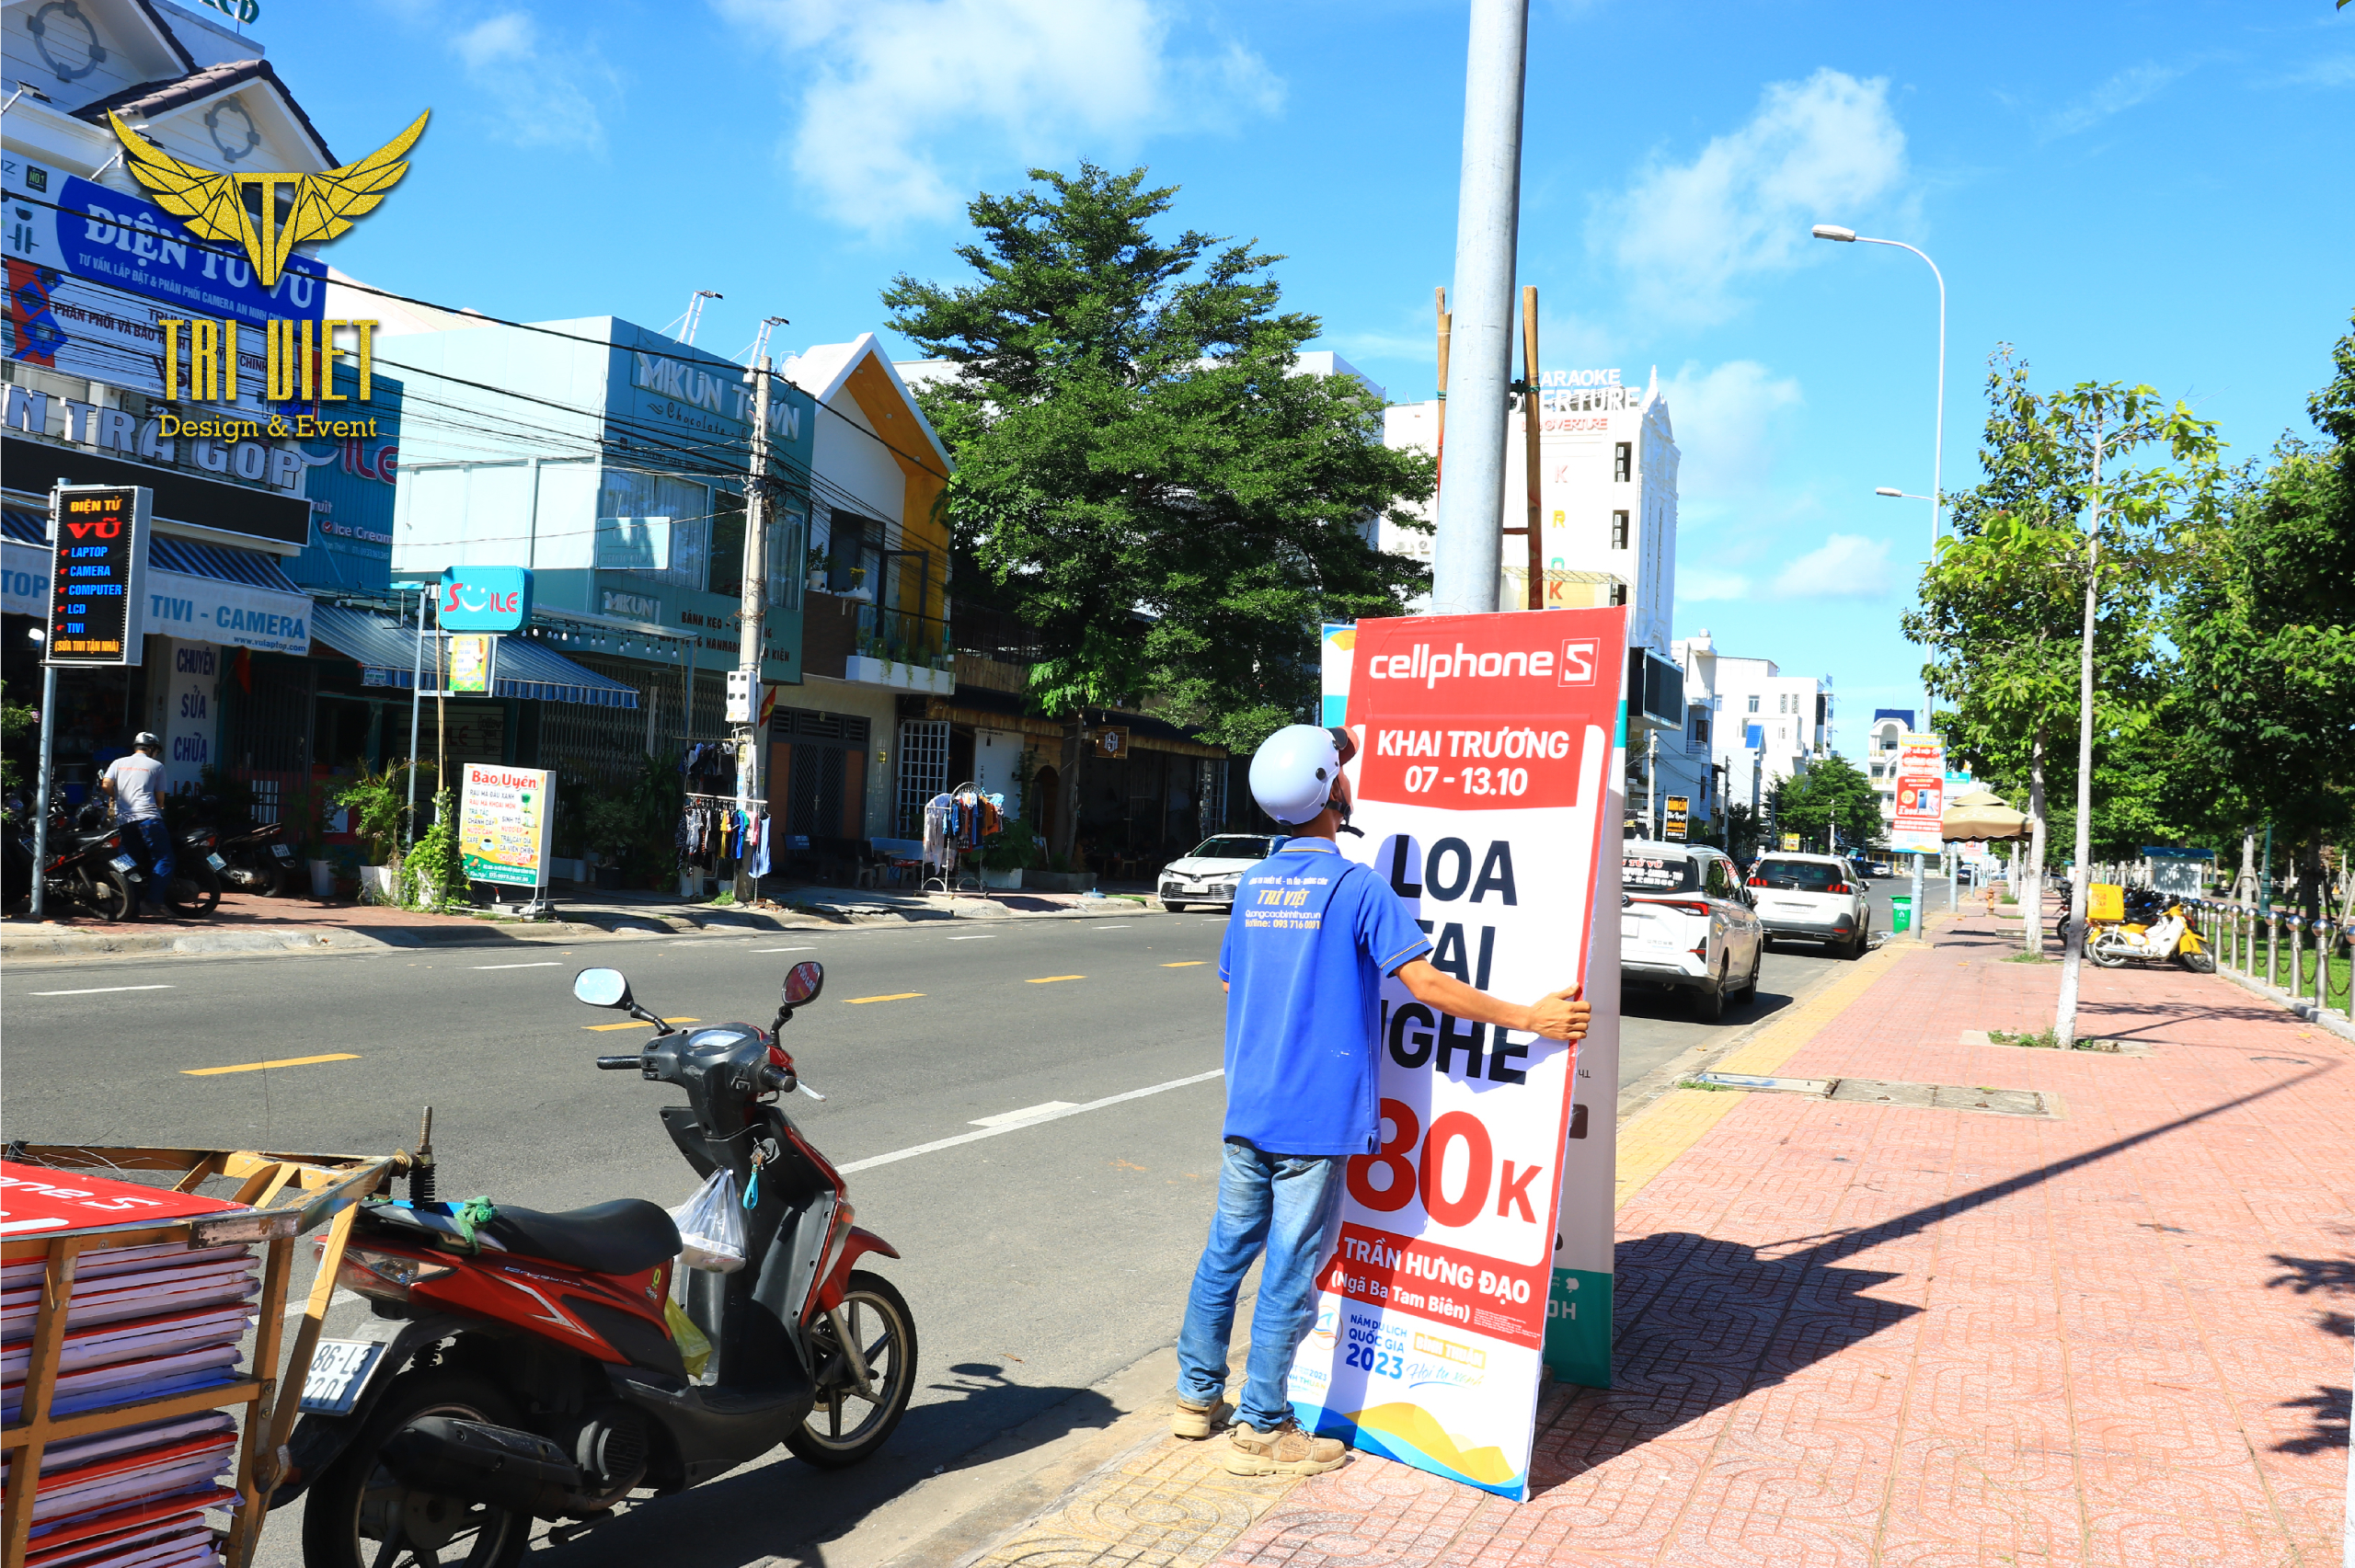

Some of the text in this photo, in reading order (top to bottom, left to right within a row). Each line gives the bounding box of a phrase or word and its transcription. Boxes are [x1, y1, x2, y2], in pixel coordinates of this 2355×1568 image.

[84, 203, 190, 269] ĐIỆN
[150, 276, 157, 287] &
[158, 278, 181, 295] PHÂN
[202, 293, 235, 313] CAMERA
[236, 302, 247, 315] AN
[249, 304, 267, 322] NINH
[1510, 387, 1640, 414] OERTURE
[668, 402, 725, 435] Chocolate
[71, 496, 122, 514] ĐIỆN TỬ
[67, 517, 122, 538] VŨ
[333, 522, 351, 537] Ice
[71, 546, 108, 557] LAPTOP
[70, 566, 110, 577] CAMERA
[68, 584, 121, 595] COMPUTER
[67, 604, 86, 614] LCD
[150, 594, 193, 622] TIVI
[216, 606, 305, 639] CAMERA
[681, 610, 704, 626] BÁNH
[707, 615, 722, 631] KẸO
[66, 623, 85, 634] TIVI
[54, 636, 119, 654] (SỬA TIVI TẬN NHÀ)
[234, 635, 306, 652] www.vulaptop.com
[177, 647, 215, 676] CHUYÊN
[181, 684, 206, 718] SỬA
[174, 732, 207, 762] CHỮA
[1376, 726, 1569, 759] KHAI TRƯƠNG
[472, 770, 536, 790] Bảo Uyên
[1405, 765, 1439, 793] 07
[1461, 766, 1528, 795] 13.10
[1390, 834, 1518, 906] LOA
[1258, 887, 1310, 908] TRÍ VIỆT
[1246, 919, 1270, 927] Hotline:
[1273, 920, 1288, 928] 093
[1290, 921, 1304, 929] 716
[1414, 919, 1496, 990] AI
[1381, 1000, 1529, 1085] GHE
[1343, 1236, 1531, 1306] TRẦN HƯNG ĐẠO
[1331, 1269, 1366, 1294] (Ngã
[1370, 1280, 1389, 1299] Ba
[1392, 1286, 1426, 1309] Tam
[1428, 1295, 1470, 1323] Biên)
[1350, 1314, 1371, 1328] NĂM
[1372, 1320, 1385, 1331] DU
[1349, 1328, 1404, 1354] QUỐC GIA
[311, 1345, 373, 1376] 86-L3
[1346, 1343, 1404, 1379] 2023
[1309, 1368, 1327, 1381] 2023
